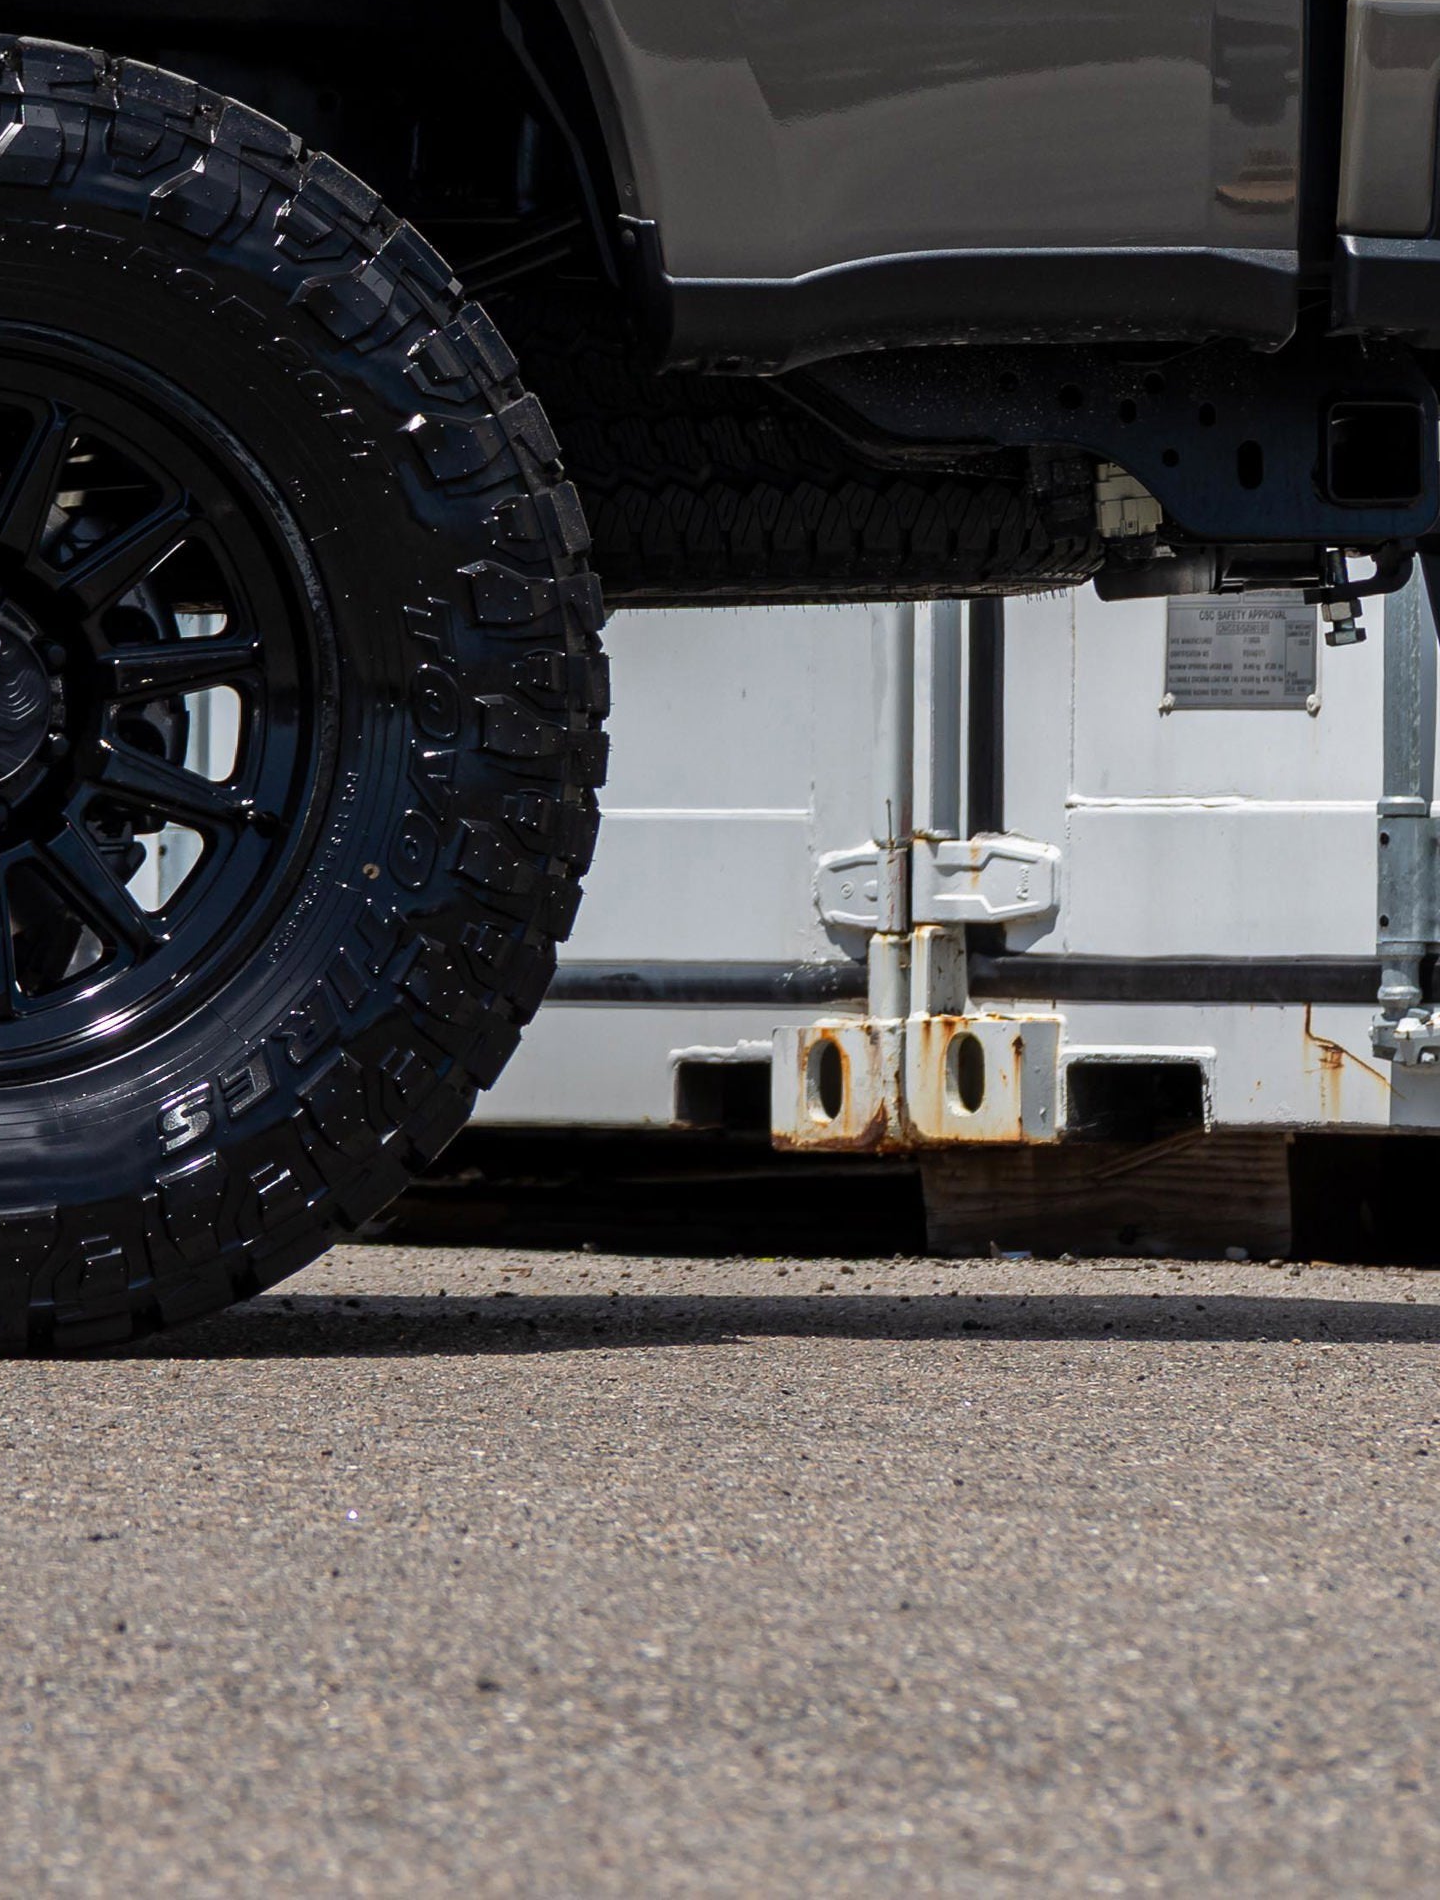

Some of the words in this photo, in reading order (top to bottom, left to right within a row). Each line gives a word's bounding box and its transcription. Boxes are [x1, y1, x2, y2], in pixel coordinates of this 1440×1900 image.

[386, 596, 463, 894] TOYO
[1199, 610, 1215, 621] CSC
[1217, 610, 1246, 620] SAFETY
[1248, 609, 1288, 620] APPROVAL
[157, 897, 410, 1160] TIRES
